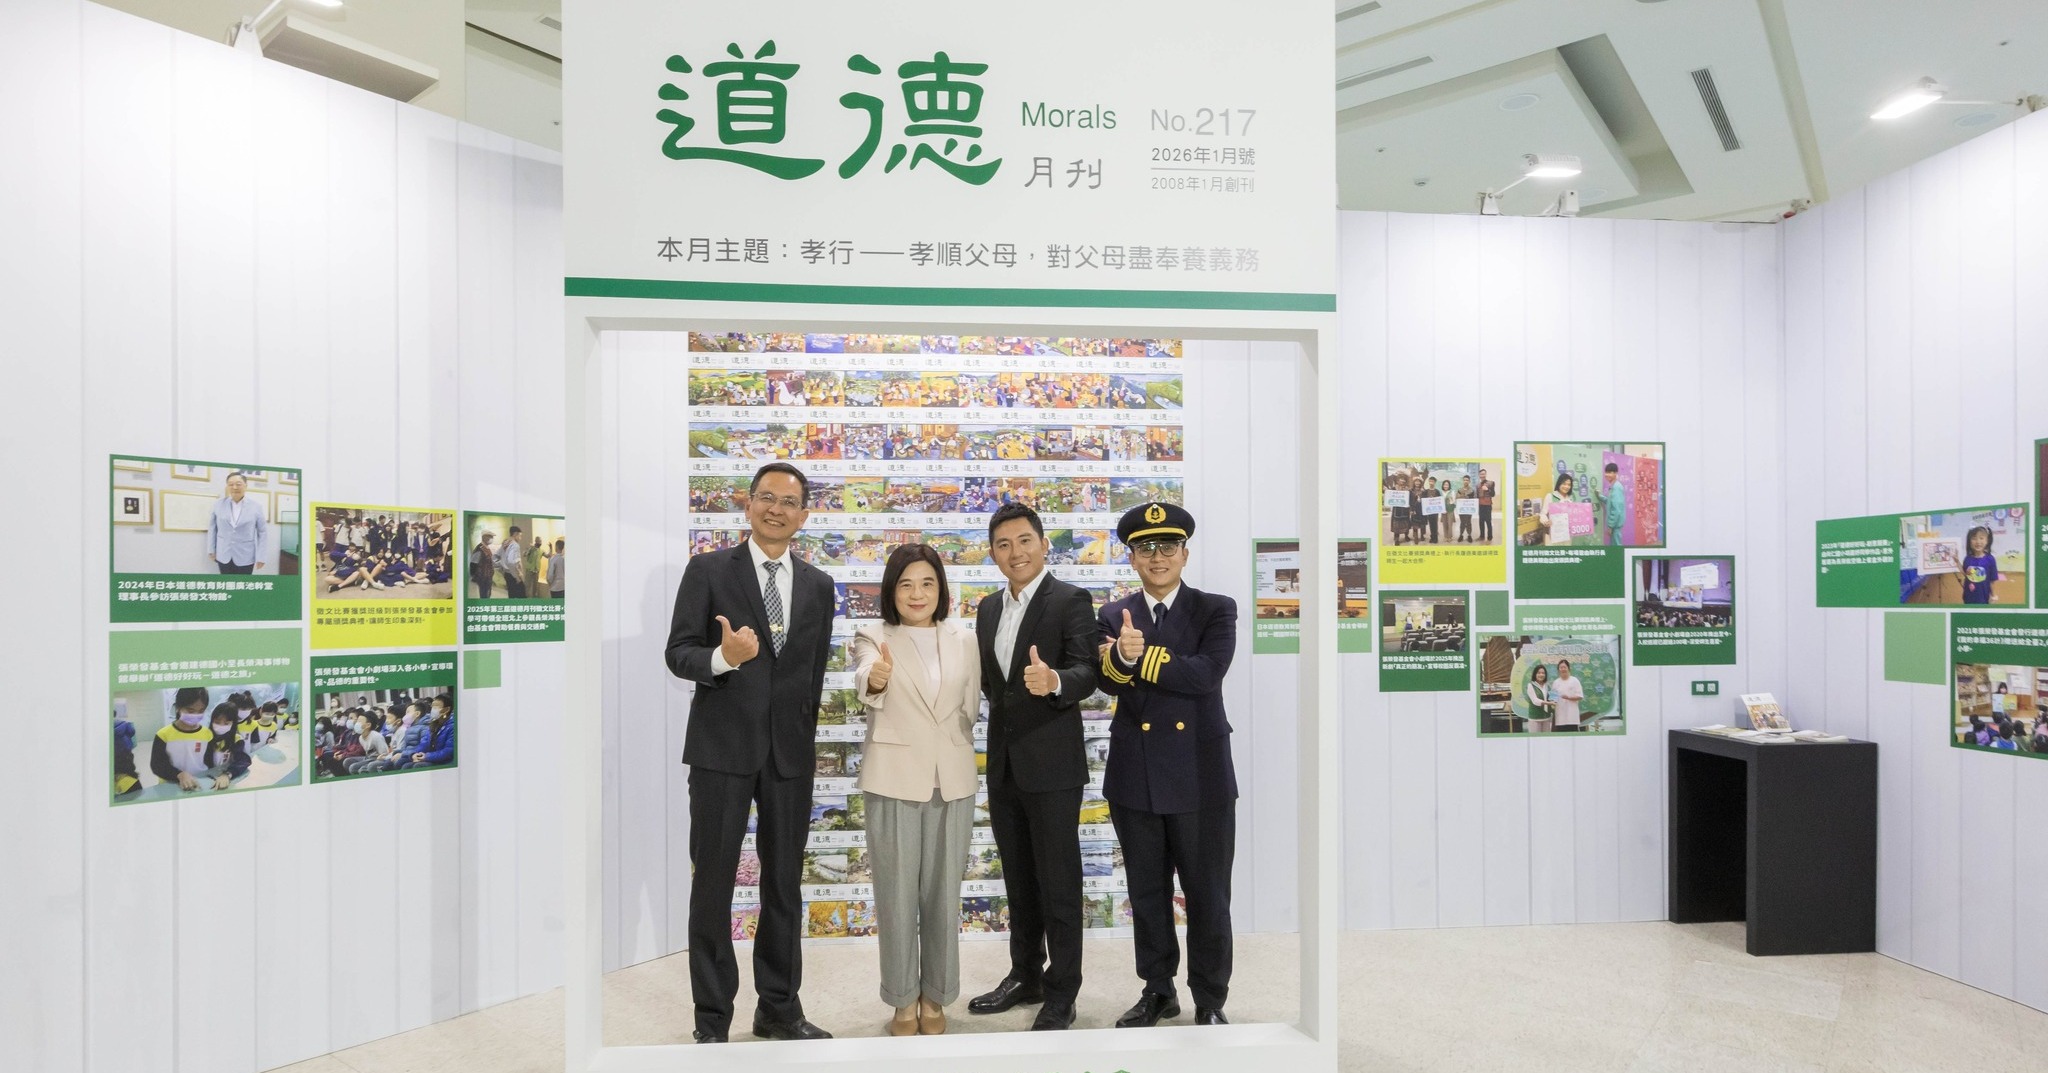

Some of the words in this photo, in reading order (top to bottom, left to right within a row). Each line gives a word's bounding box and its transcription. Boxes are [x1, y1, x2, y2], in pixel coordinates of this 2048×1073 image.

[656, 39, 1003, 187] 道德
[1021, 101, 1118, 130] Morals
[1150, 107, 1256, 138] No.217
[1151, 146, 1256, 166] 2026年1月號
[1024, 156, 1103, 190] 月刊
[1151, 175, 1256, 194] 2008年1月創刊
[1571, 525, 1590, 534] 3000
